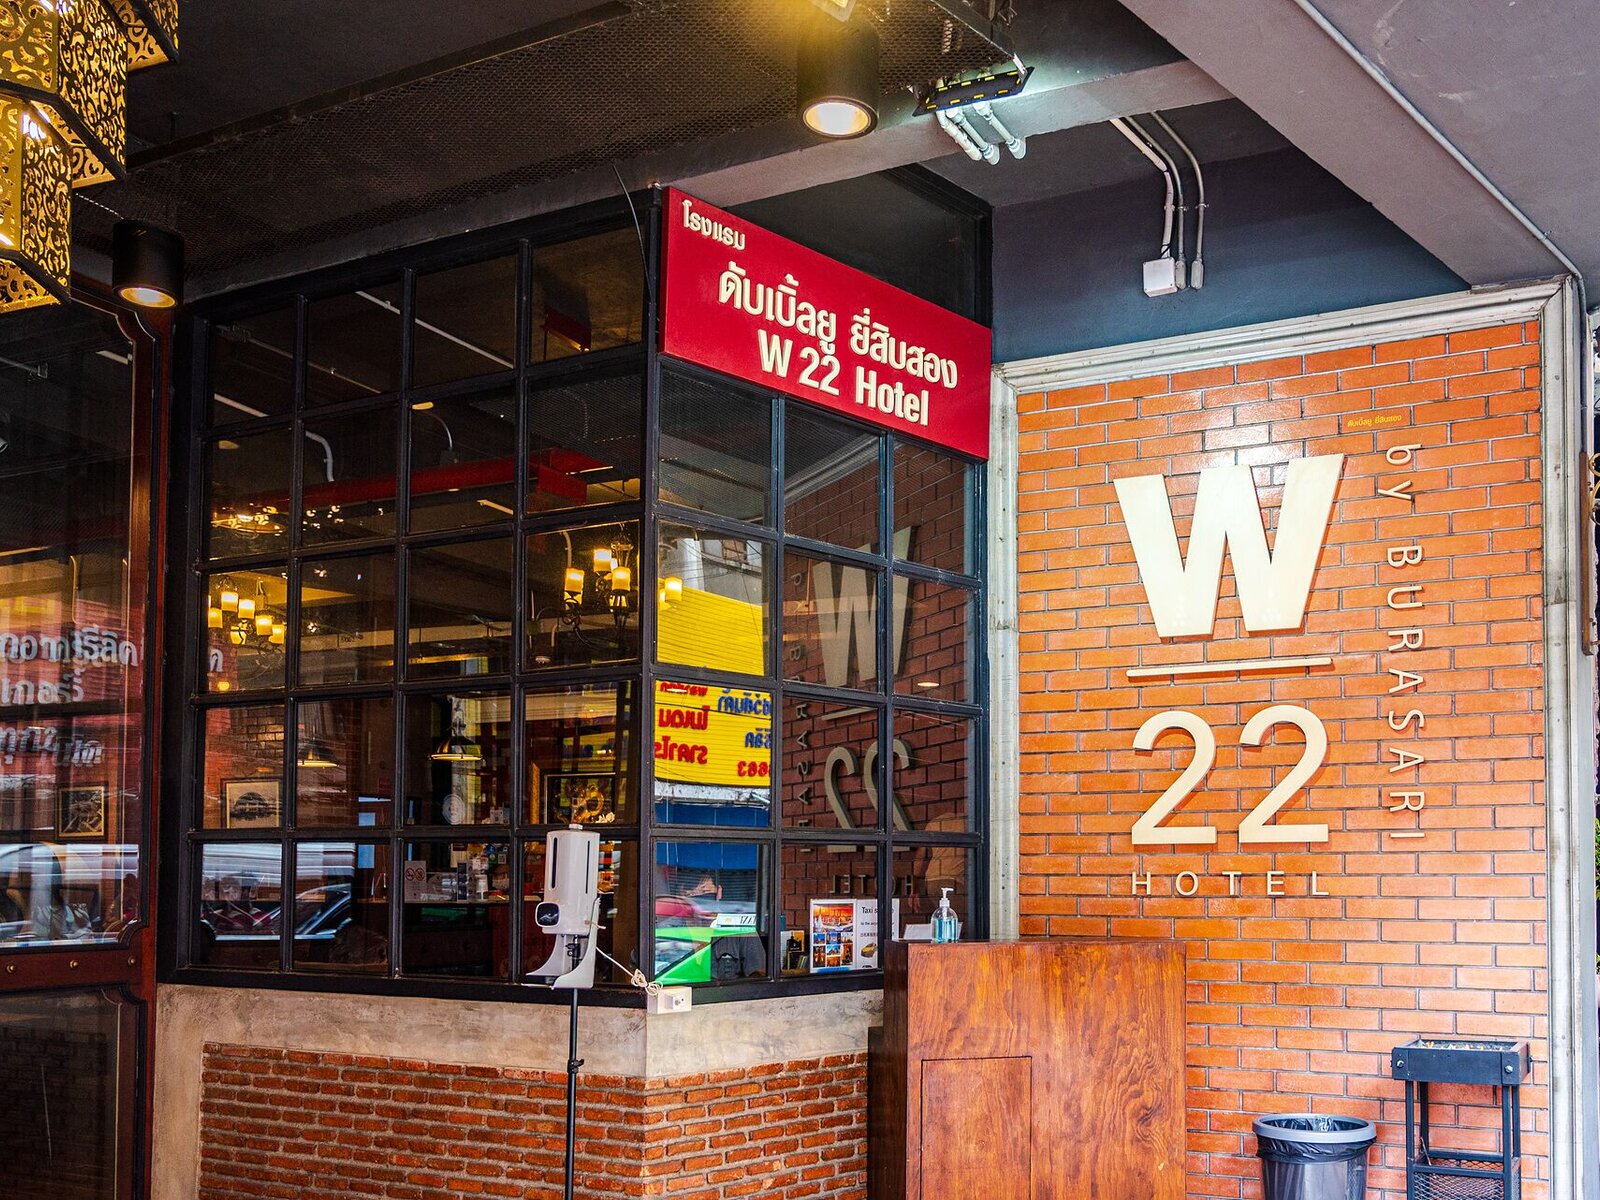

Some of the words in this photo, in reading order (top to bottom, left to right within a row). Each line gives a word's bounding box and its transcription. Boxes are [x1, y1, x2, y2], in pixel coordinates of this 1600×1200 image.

[682, 198, 746, 251] โรงแรม
[718, 261, 838, 355] ดับเบิ้ลยู
[850, 308, 959, 389] ยี่สิบสอง
[758, 329, 793, 379] W
[798, 347, 841, 397] 22
[855, 366, 930, 427] Hotel
[1376, 442, 1423, 502] by
[1113, 453, 1346, 639] W
[1385, 544, 1425, 839] BURASARI
[1130, 703, 1330, 846] 22
[1130, 870, 1331, 898] HOTEL
